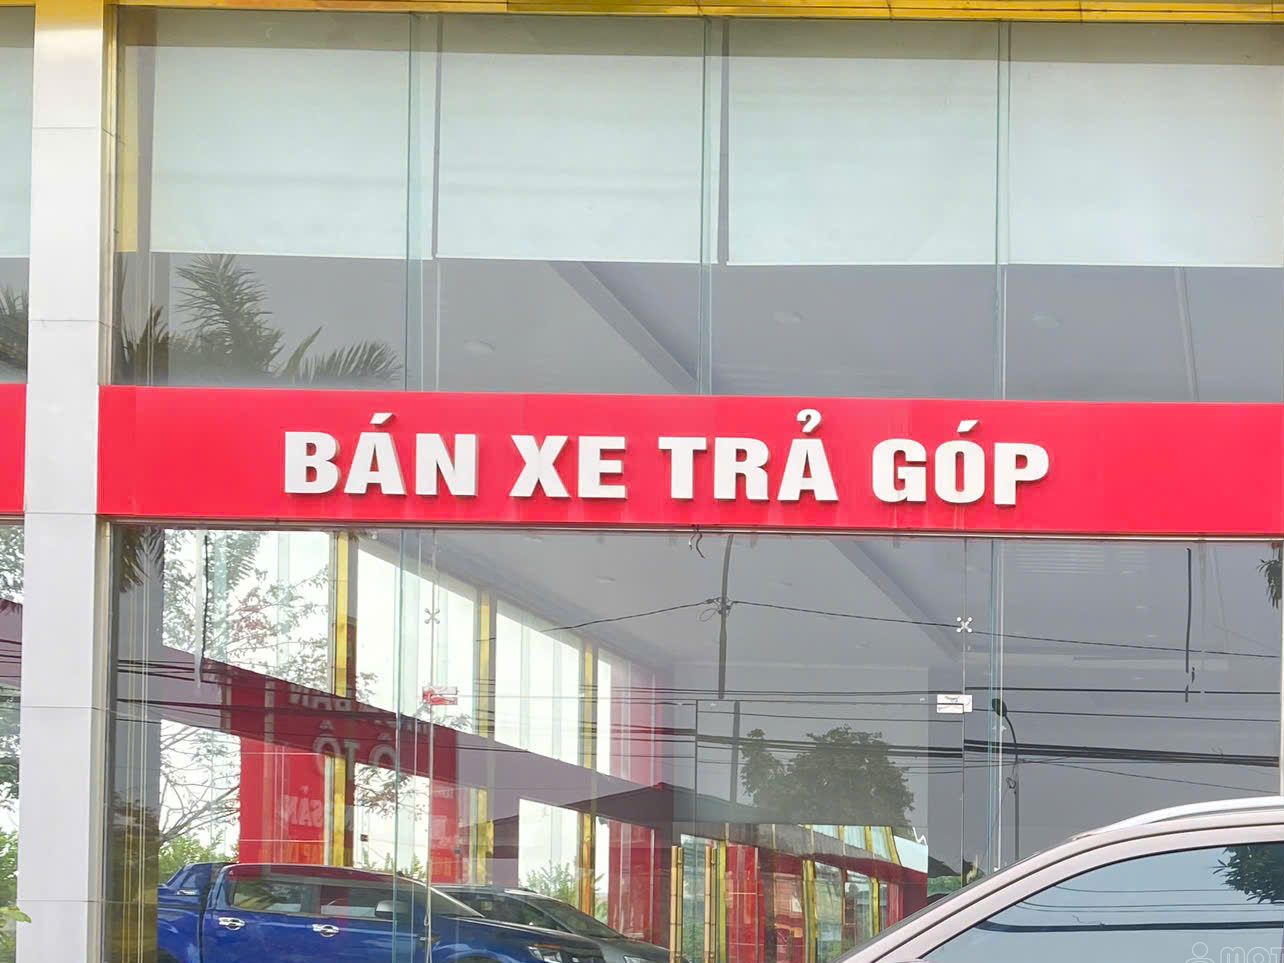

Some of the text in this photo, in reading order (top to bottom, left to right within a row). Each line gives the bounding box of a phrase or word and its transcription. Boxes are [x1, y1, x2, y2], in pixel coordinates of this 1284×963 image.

[285, 408, 1050, 508] BÁN XE TRẢ GÓP
